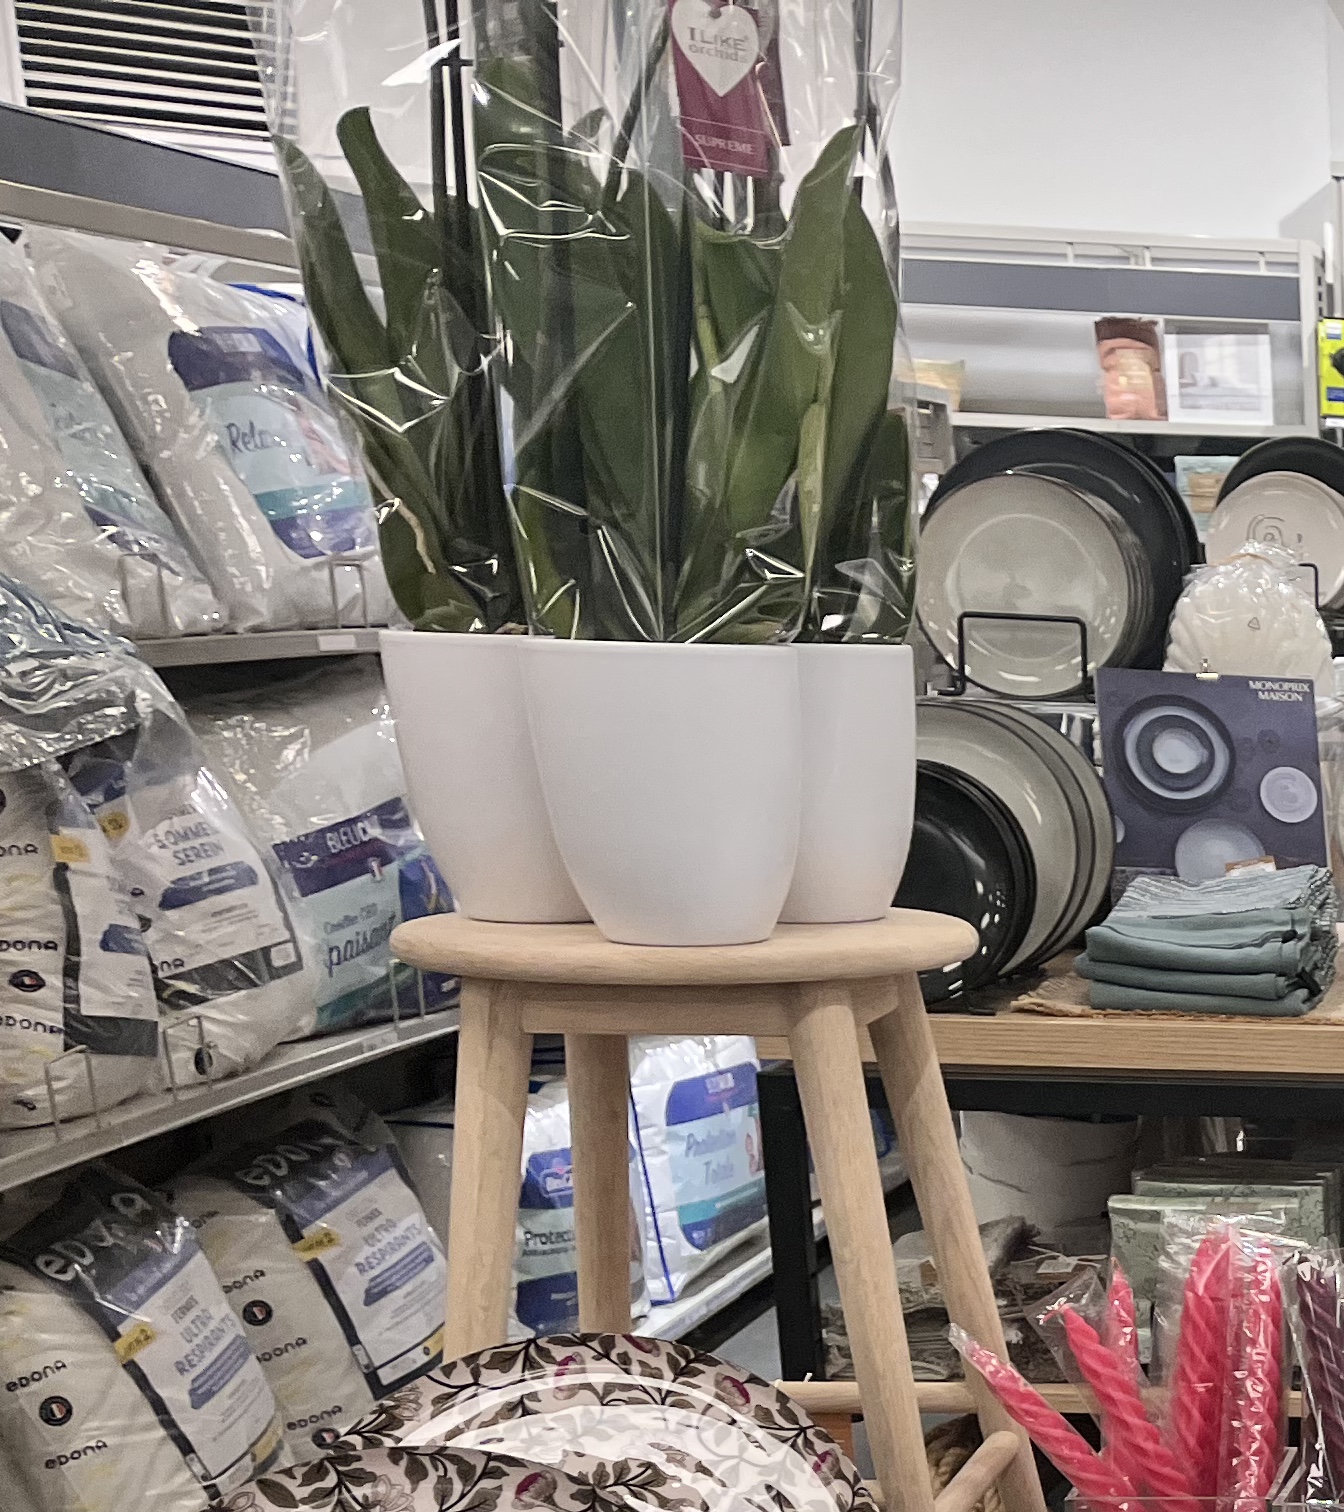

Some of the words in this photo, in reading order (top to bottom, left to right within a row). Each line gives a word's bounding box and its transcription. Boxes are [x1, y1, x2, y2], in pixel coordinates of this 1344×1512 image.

[700, 29, 744, 51] LIKE
[695, 133, 754, 153] SUPREME
[224, 419, 278, 453] Rela
[1249, 679, 1310, 693] MONOPRIX
[1258, 690, 1304, 702] MAISON
